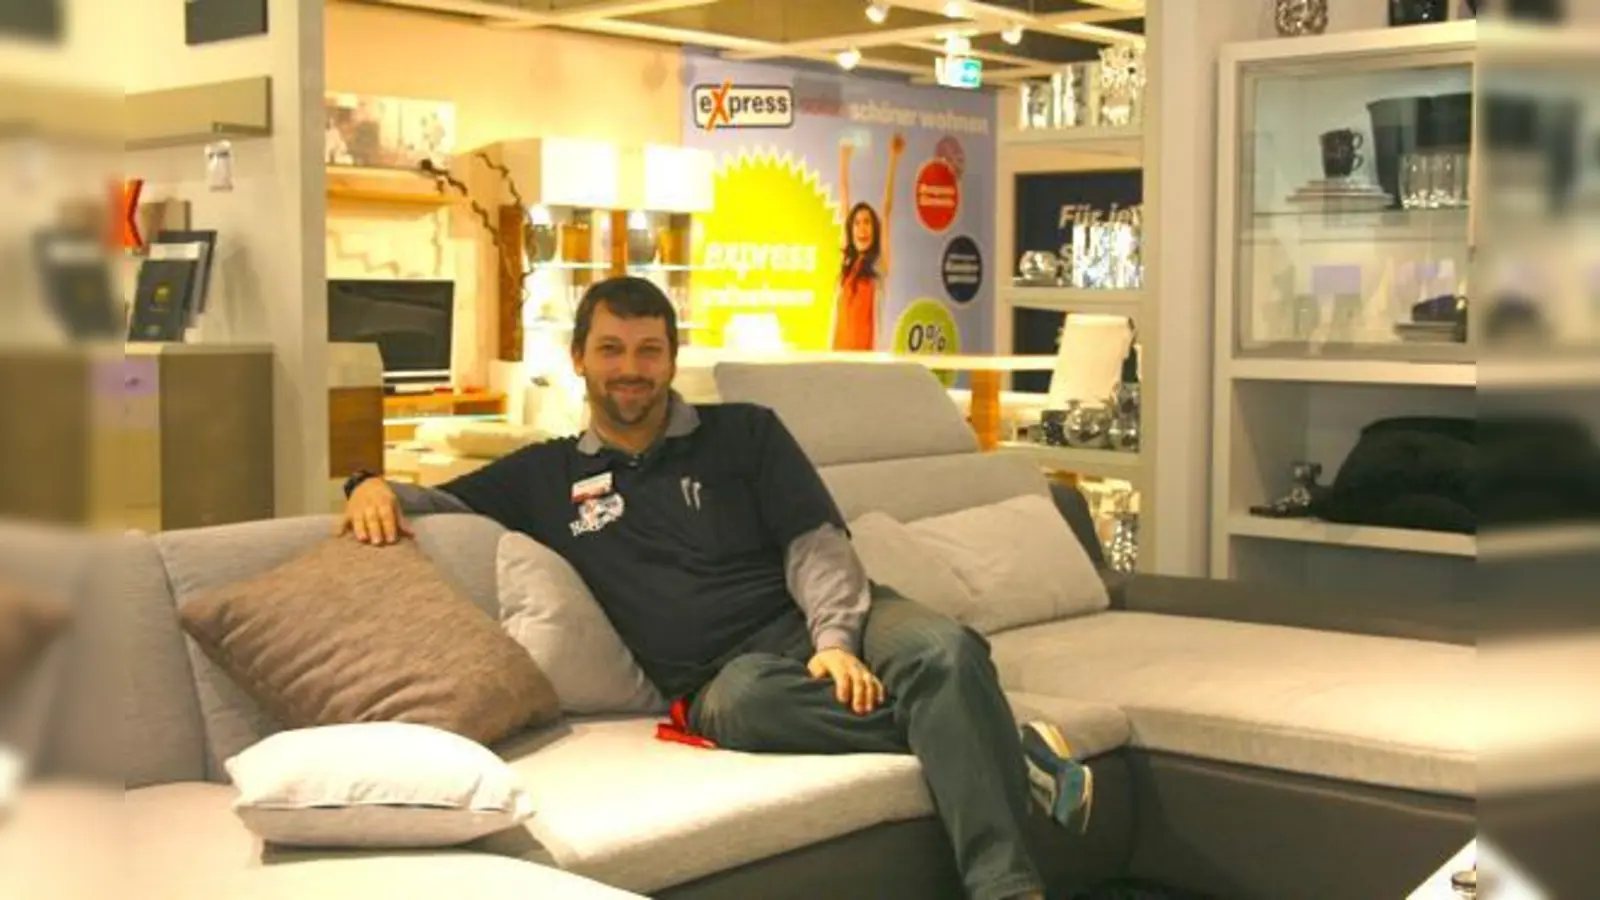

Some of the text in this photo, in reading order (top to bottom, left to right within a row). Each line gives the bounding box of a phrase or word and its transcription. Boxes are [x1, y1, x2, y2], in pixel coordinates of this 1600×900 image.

[920, 108, 989, 135] wohnen
[1058, 202, 1104, 229] Für
[704, 242, 818, 280] express
[908, 322, 946, 352] 0%
